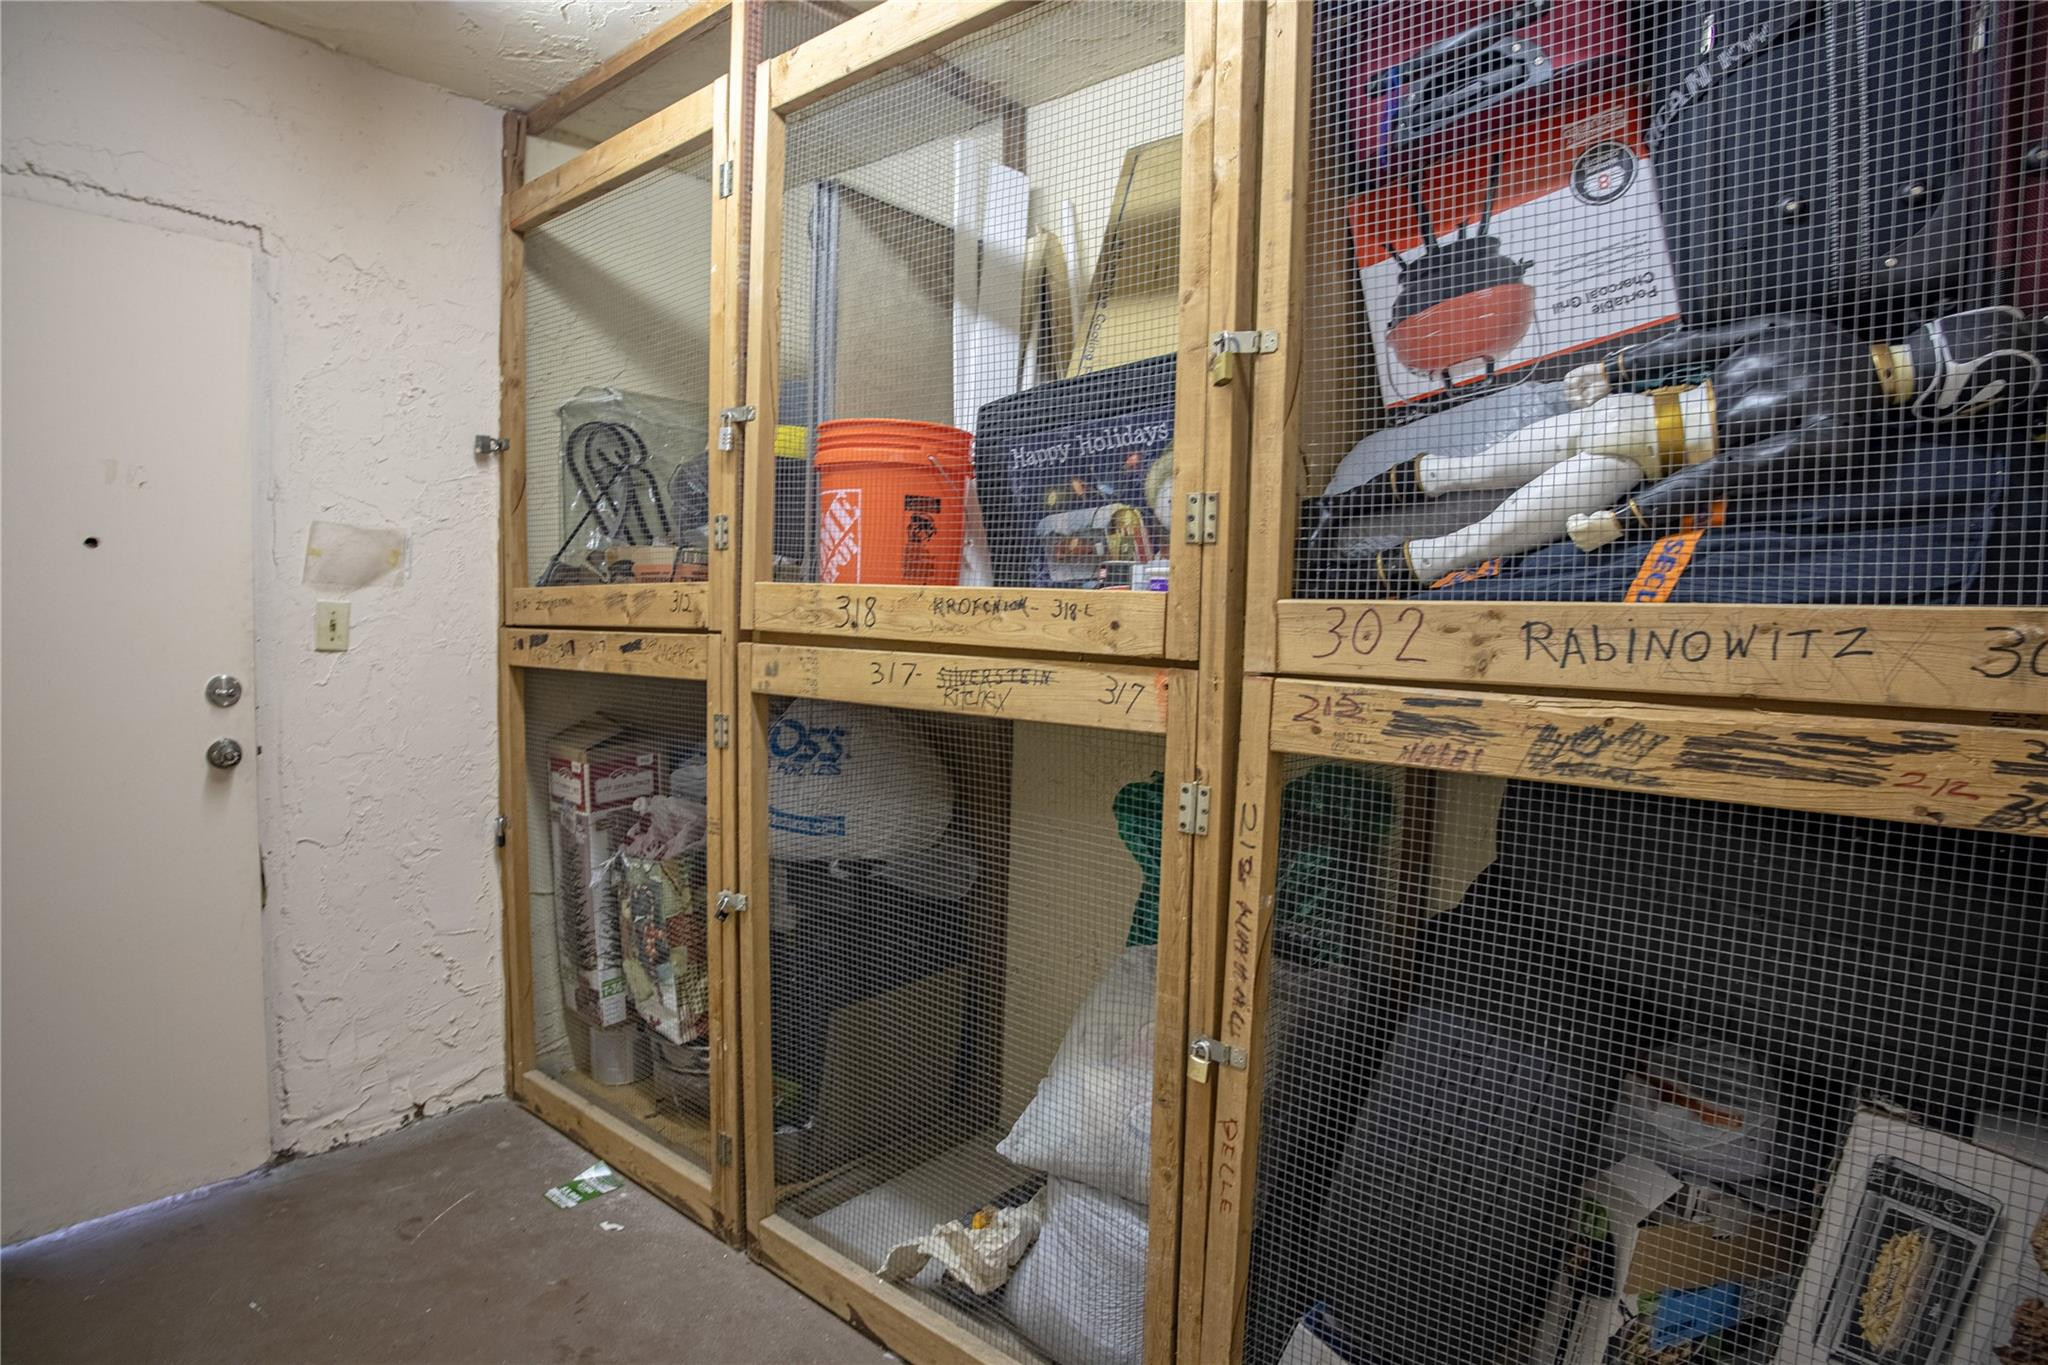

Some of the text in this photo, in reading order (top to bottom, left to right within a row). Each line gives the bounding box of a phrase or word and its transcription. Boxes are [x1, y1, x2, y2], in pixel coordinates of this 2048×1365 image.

[1585, 271, 1655, 304] Charcoal
[1591, 286, 1658, 314] Portable
[1011, 422, 1169, 470] Happy Holidays
[835, 595, 878, 629] 318
[1312, 607, 1428, 663] 302
[1098, 675, 1145, 713] 317
[1893, 771, 1980, 801] 212
